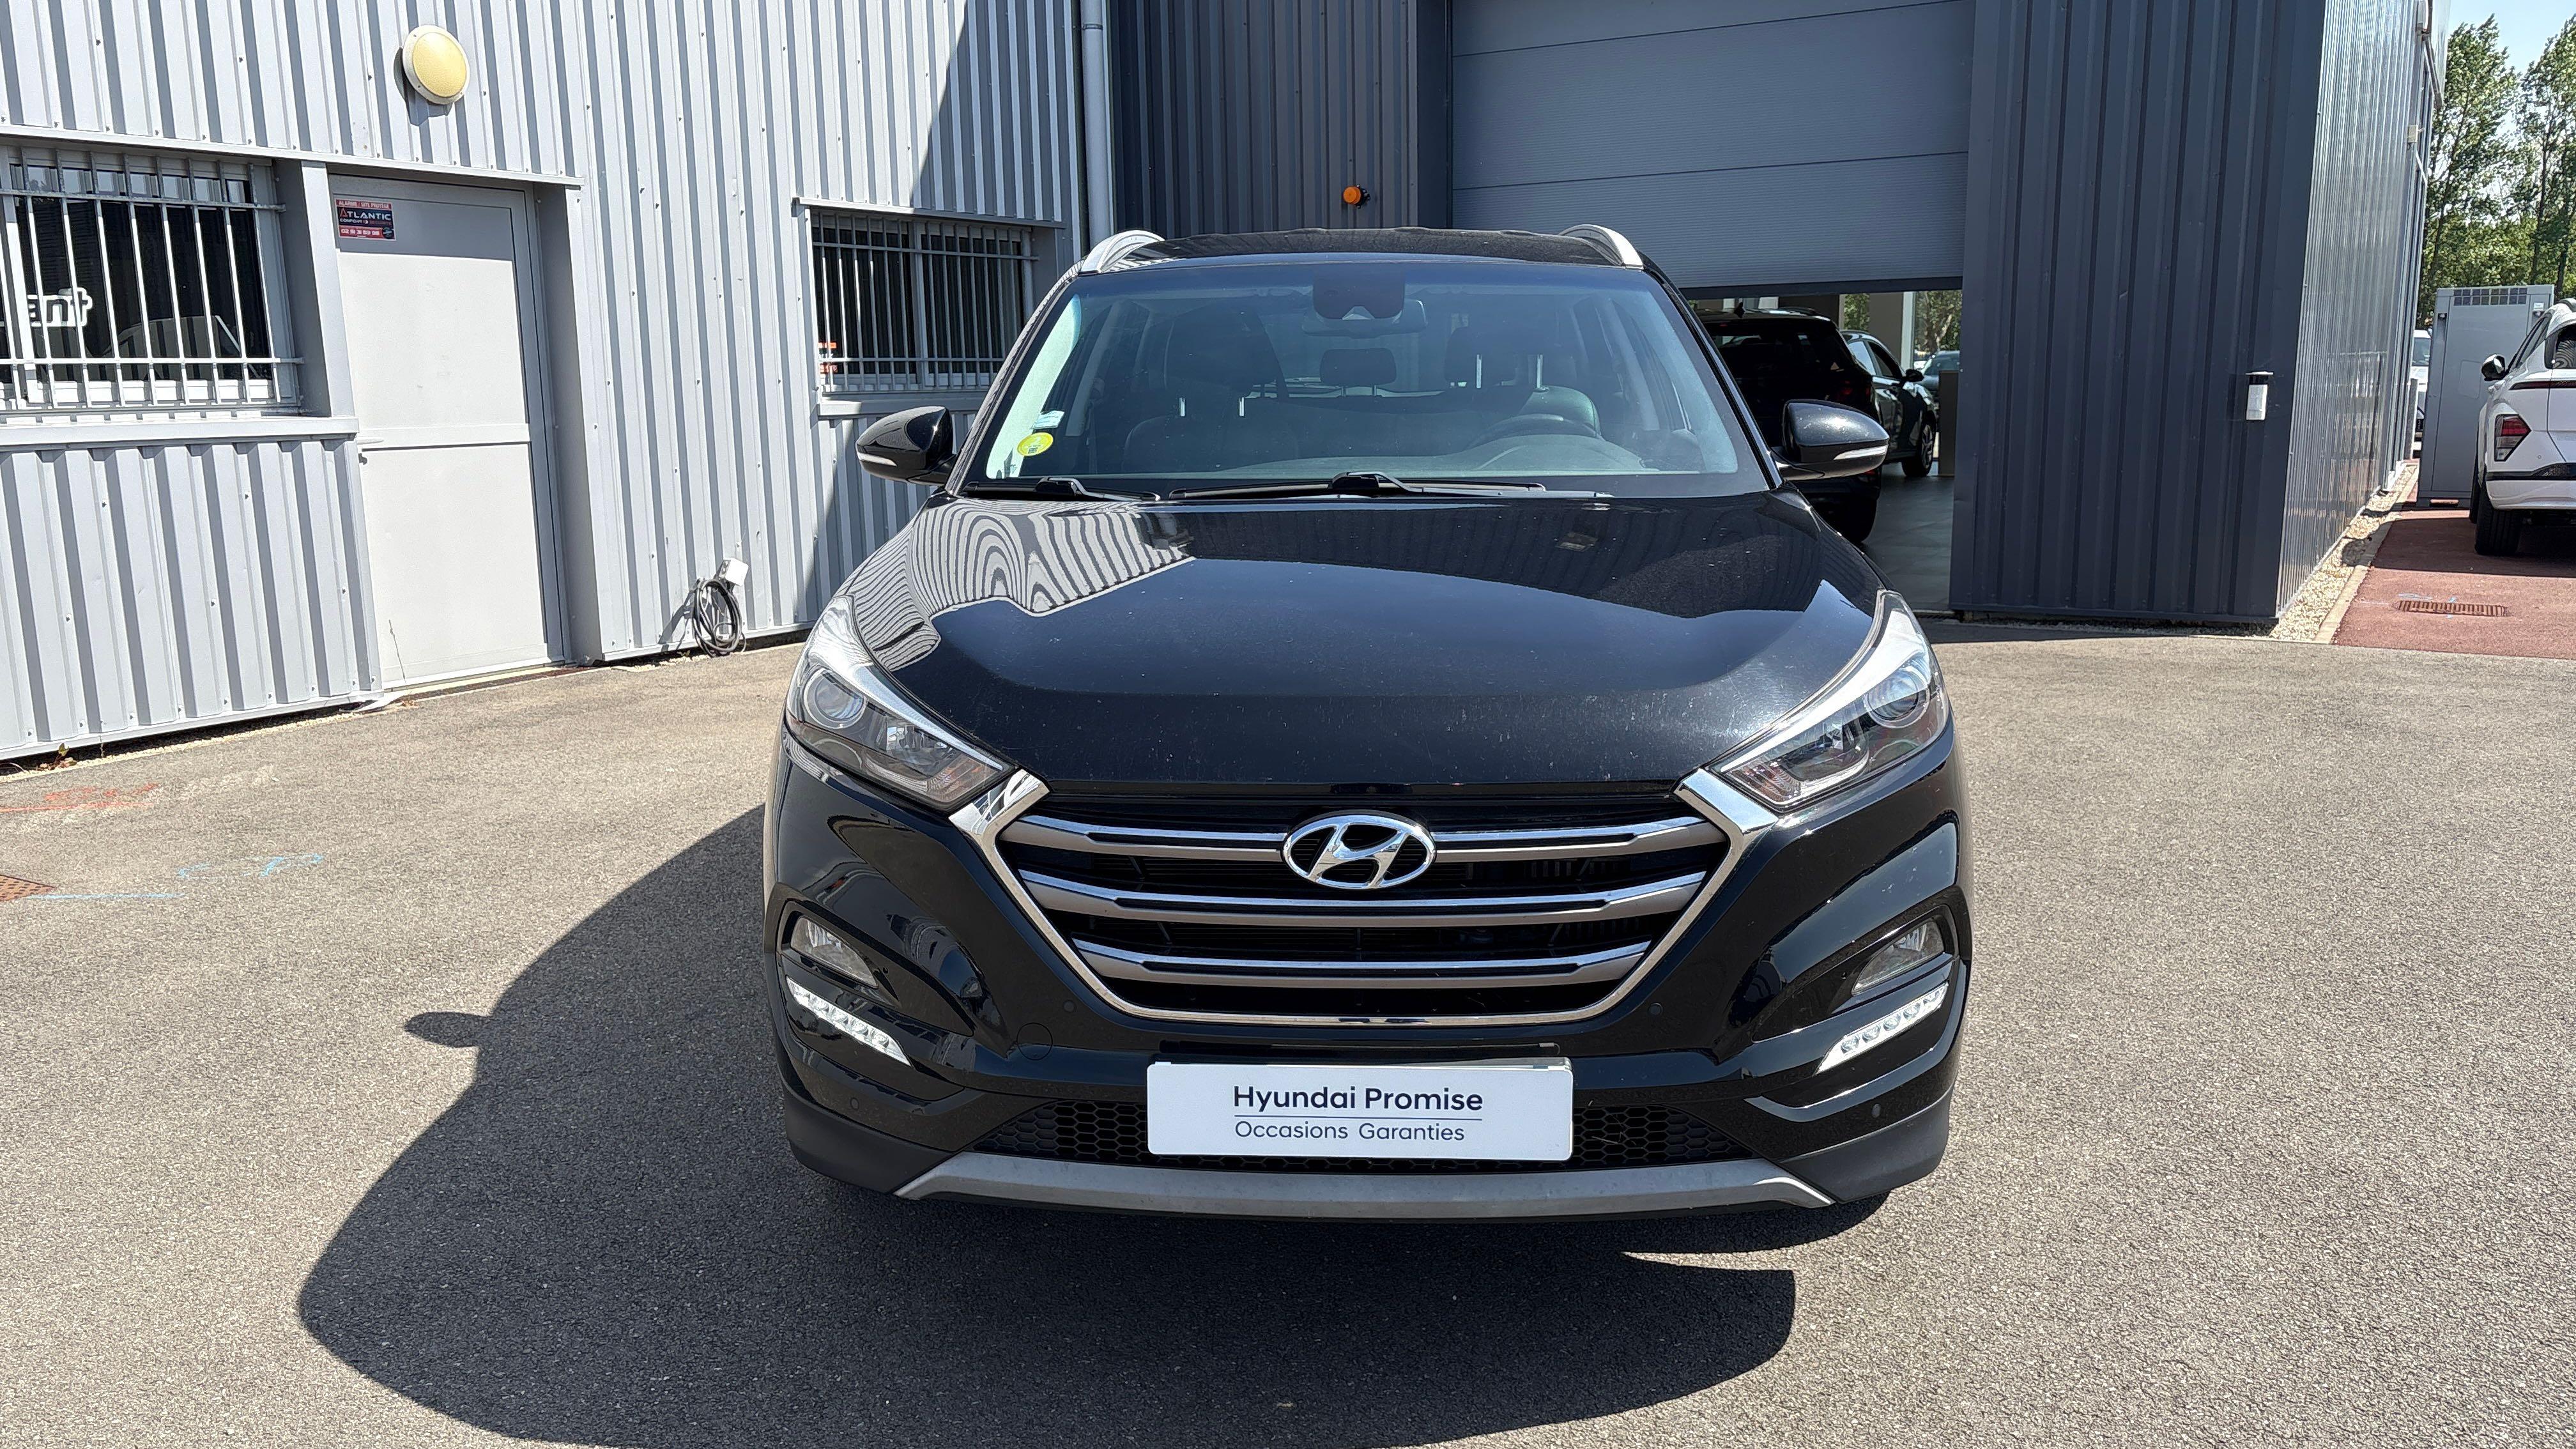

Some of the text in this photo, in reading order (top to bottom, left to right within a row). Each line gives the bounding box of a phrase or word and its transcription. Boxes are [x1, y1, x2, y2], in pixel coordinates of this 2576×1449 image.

[339, 208, 391, 220] ATLANTIC
[1234, 1085, 1483, 1112] Hyundai Promise
[1235, 1121, 1465, 1141] Occasions Garanties
